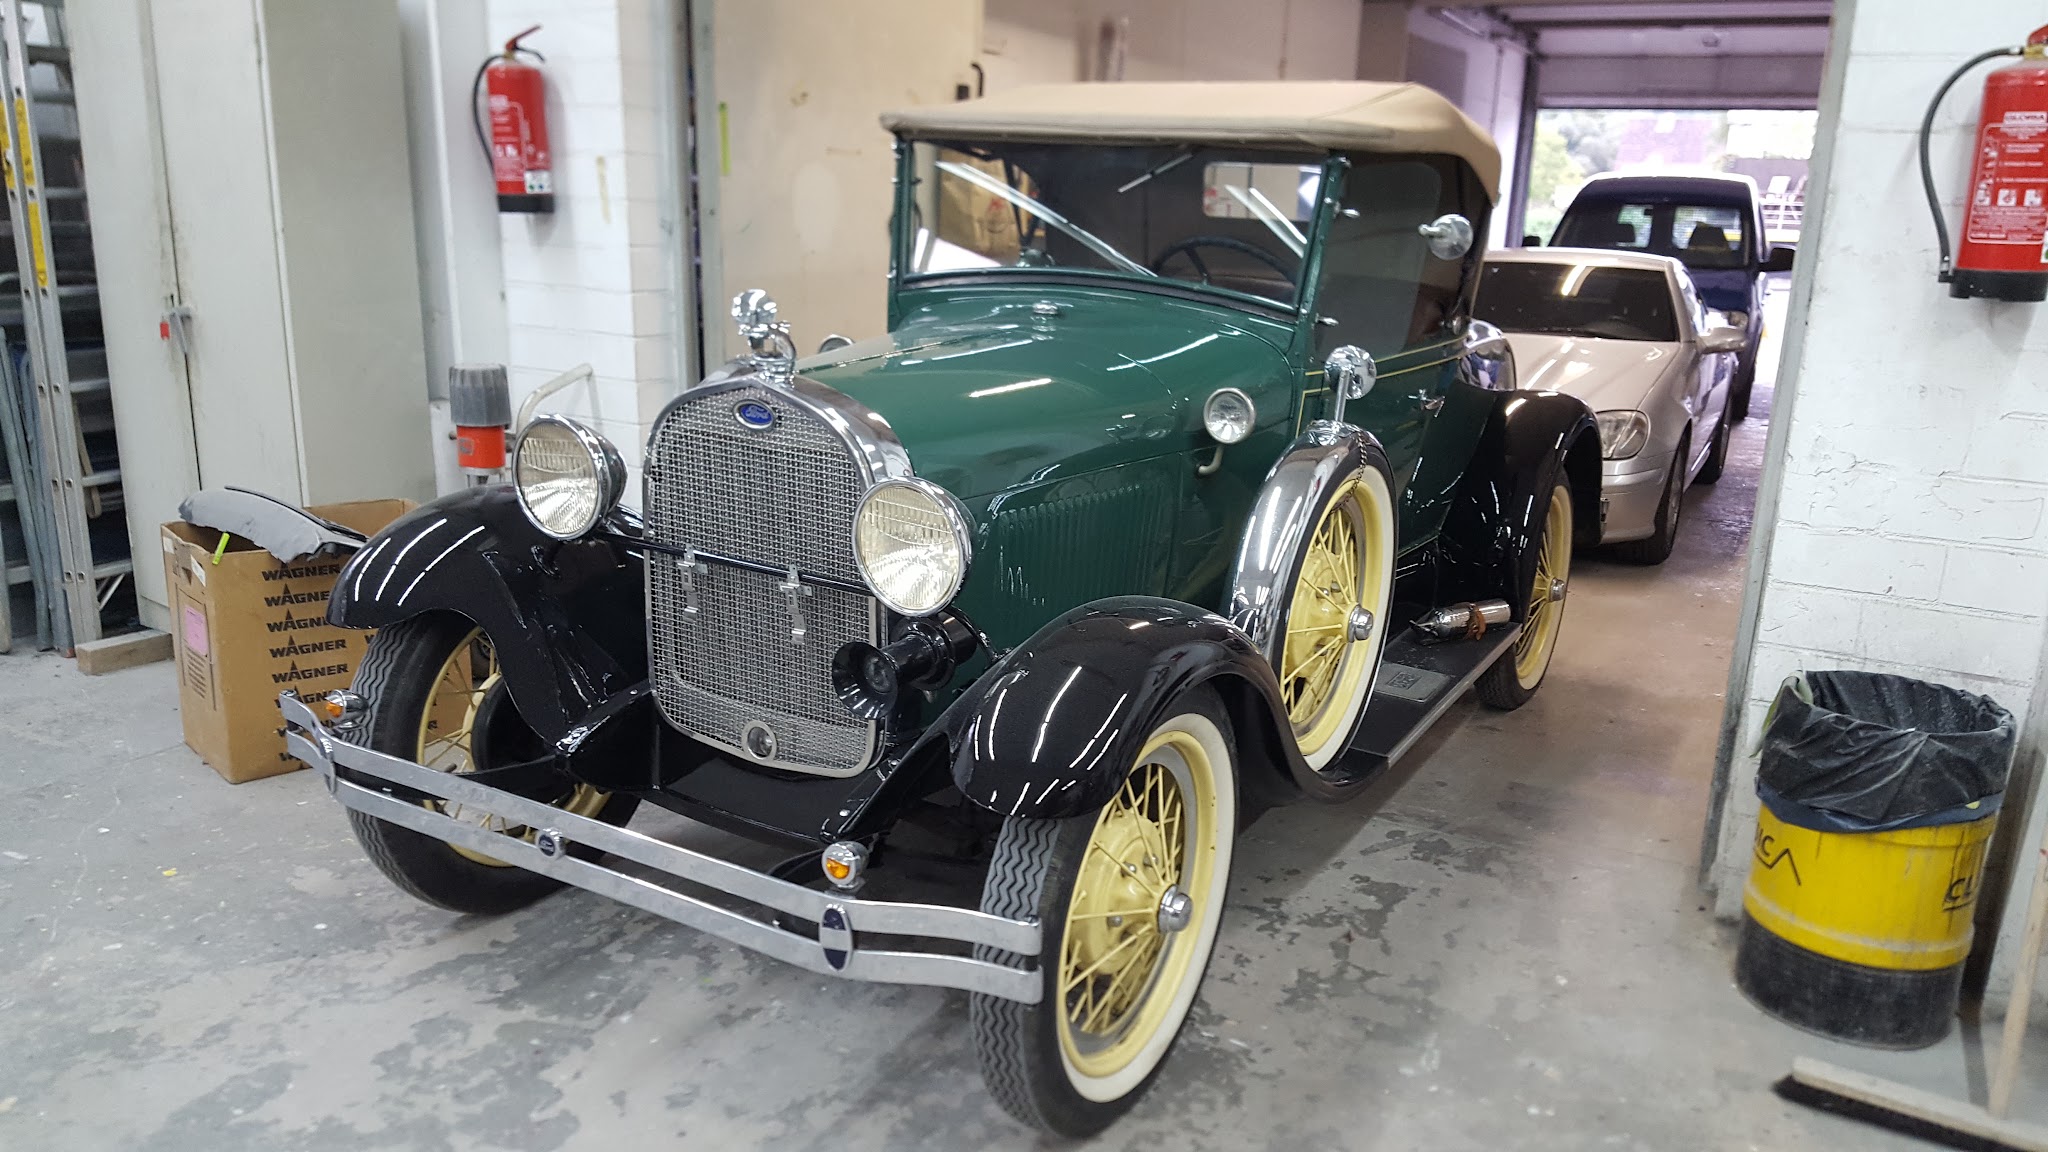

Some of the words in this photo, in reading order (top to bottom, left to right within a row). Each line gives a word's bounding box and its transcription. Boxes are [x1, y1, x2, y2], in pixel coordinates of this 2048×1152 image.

[262, 563, 340, 581] WAGNER
[264, 583, 330, 607] WAGNE
[266, 608, 329, 632] WAGN
[269, 634, 347, 658] WAGNER
[272, 660, 349, 684] WAGNER
